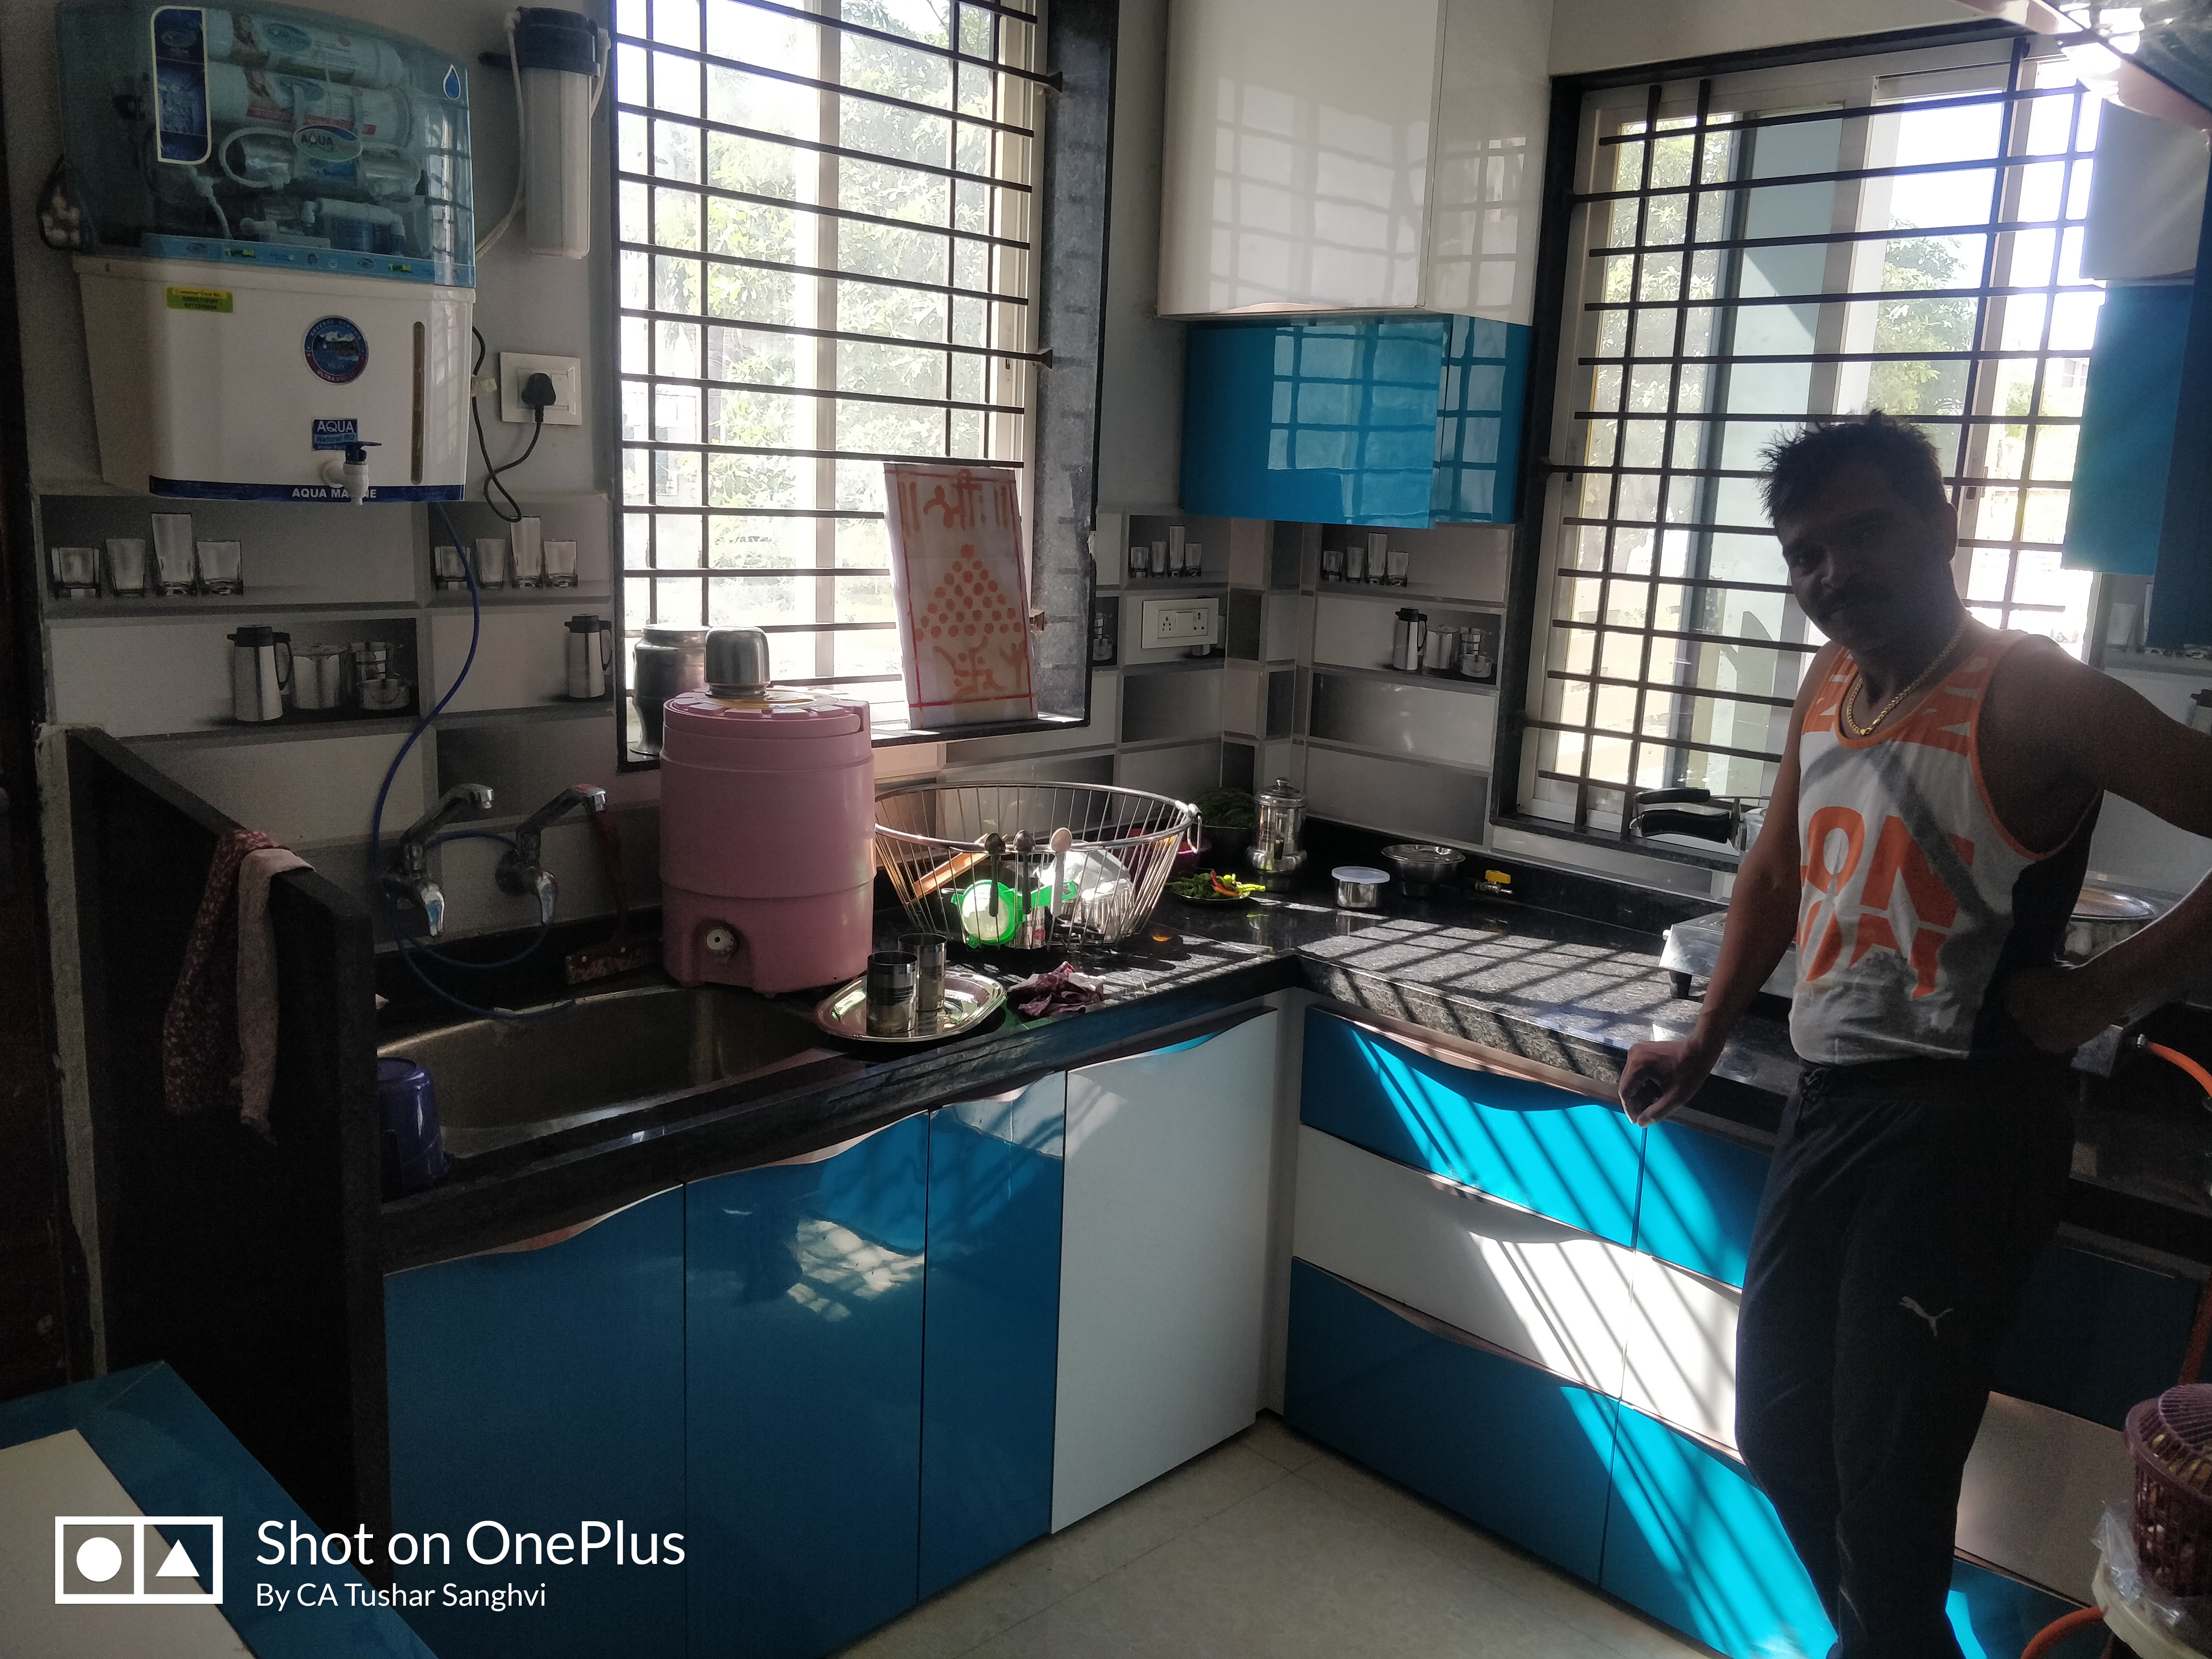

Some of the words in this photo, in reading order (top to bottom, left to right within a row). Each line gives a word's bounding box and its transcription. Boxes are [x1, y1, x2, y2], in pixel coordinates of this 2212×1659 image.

[301, 132, 334, 150] AQUA
[317, 420, 354, 433] AQUA
[316, 434, 342, 443] Natural
[292, 488, 327, 498] AQUA
